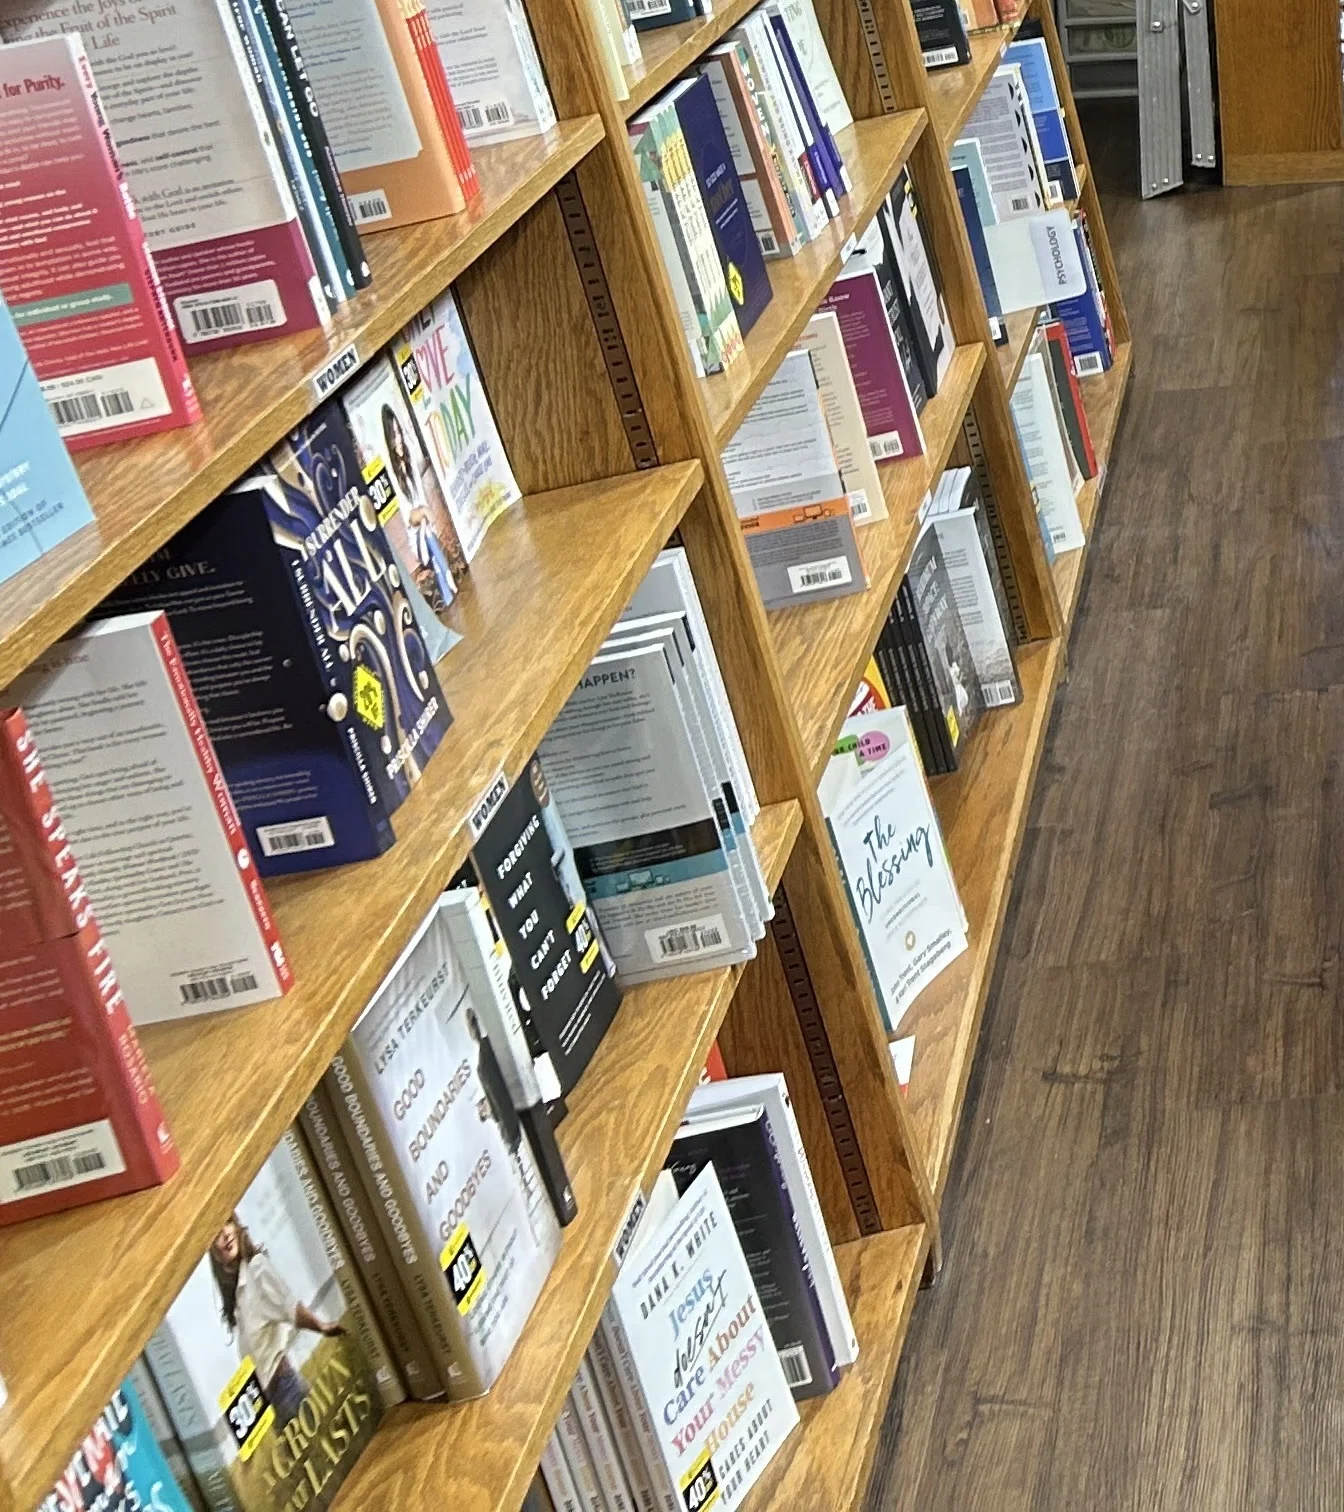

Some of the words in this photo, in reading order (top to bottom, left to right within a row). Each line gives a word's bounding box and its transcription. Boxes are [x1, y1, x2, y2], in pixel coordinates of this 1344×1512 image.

[138, 3, 177, 28] Spirit
[1045, 224, 1068, 287] PSYCHOLOGY
[315, 347, 358, 393] WOMEN
[471, 777, 509, 828] WOMEN
[496, 812, 541, 881] FORGIVING
[507, 870, 535, 908] WHAT
[518, 906, 540, 942] YOU
[530, 935, 557, 972] CAN'T
[540, 949, 573, 1002] FORGET
[393, 1068, 427, 1121] GOOD
[408, 1058, 473, 1164] BOUNDARIES
[424, 1160, 450, 1205] AND
[438, 1149, 493, 1242] GOODBYES
